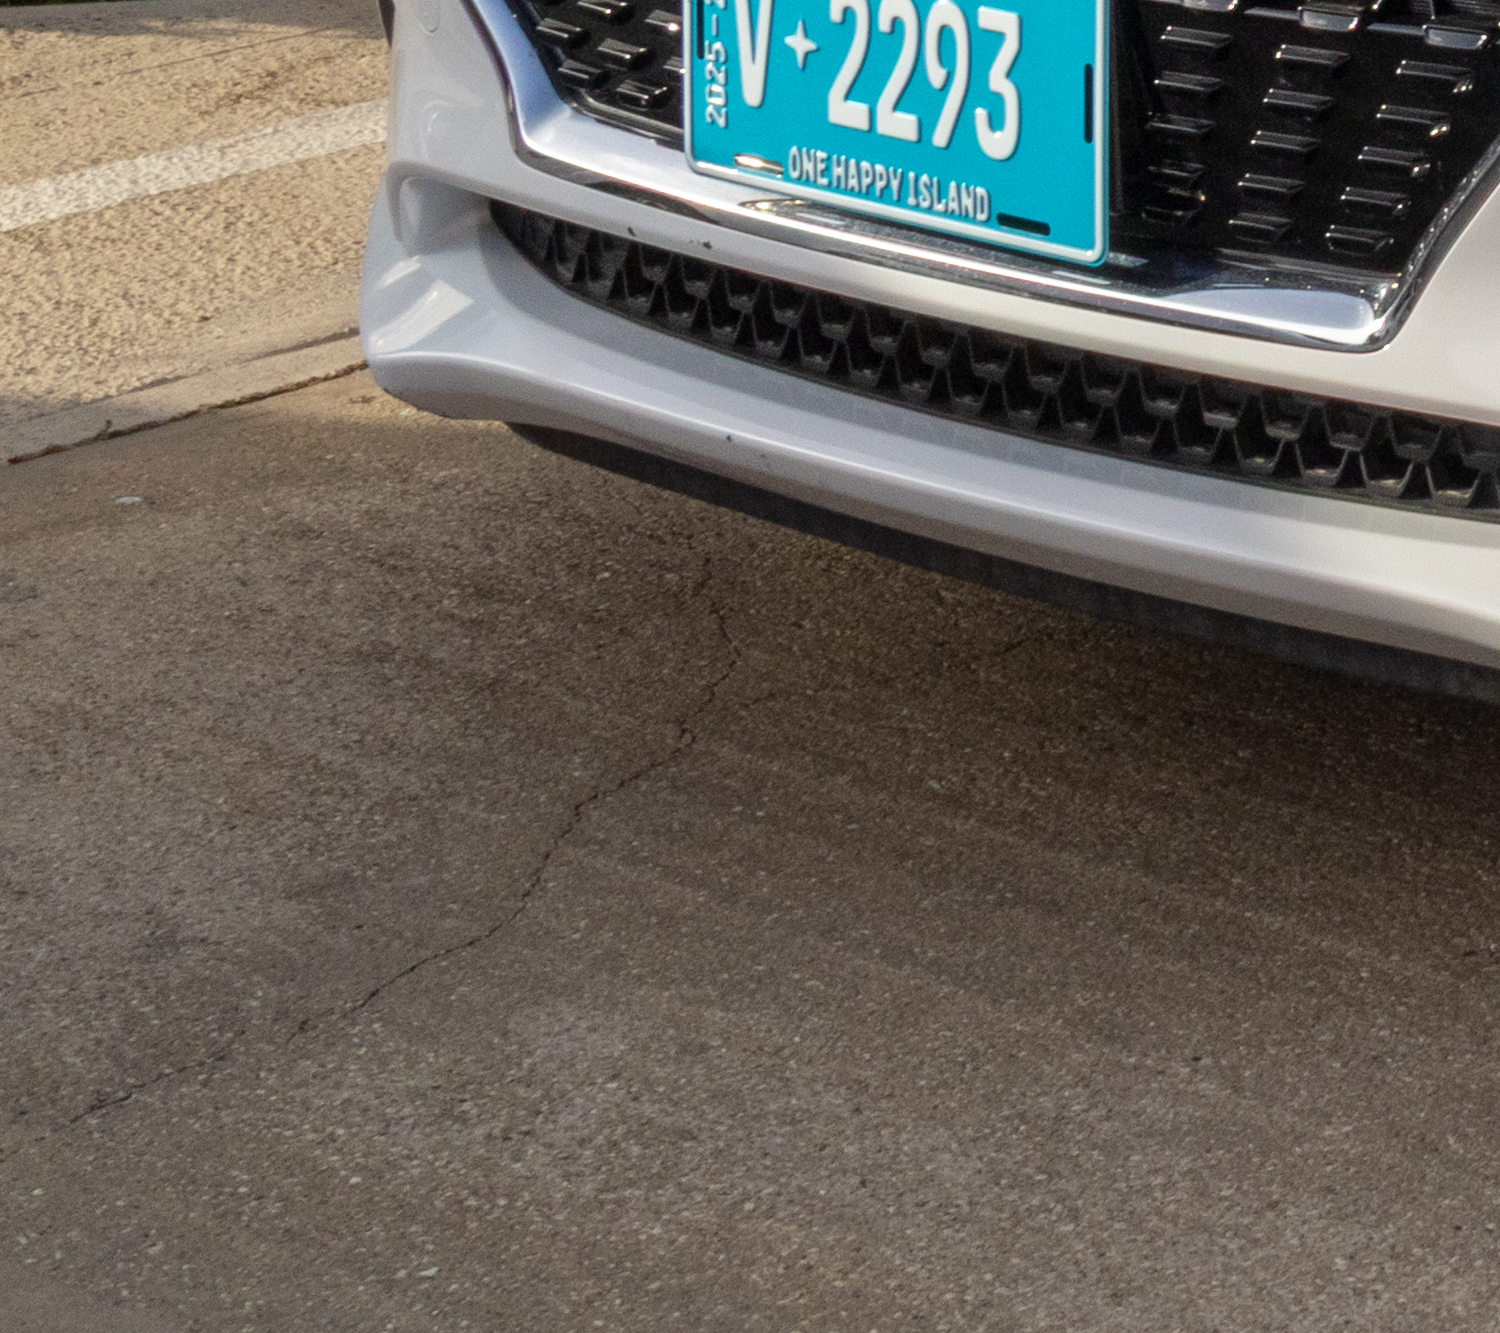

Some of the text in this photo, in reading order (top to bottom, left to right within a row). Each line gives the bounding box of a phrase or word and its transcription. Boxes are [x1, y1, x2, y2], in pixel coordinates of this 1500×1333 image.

[788, 145, 992, 224] ONE HAPPY ISLAND
